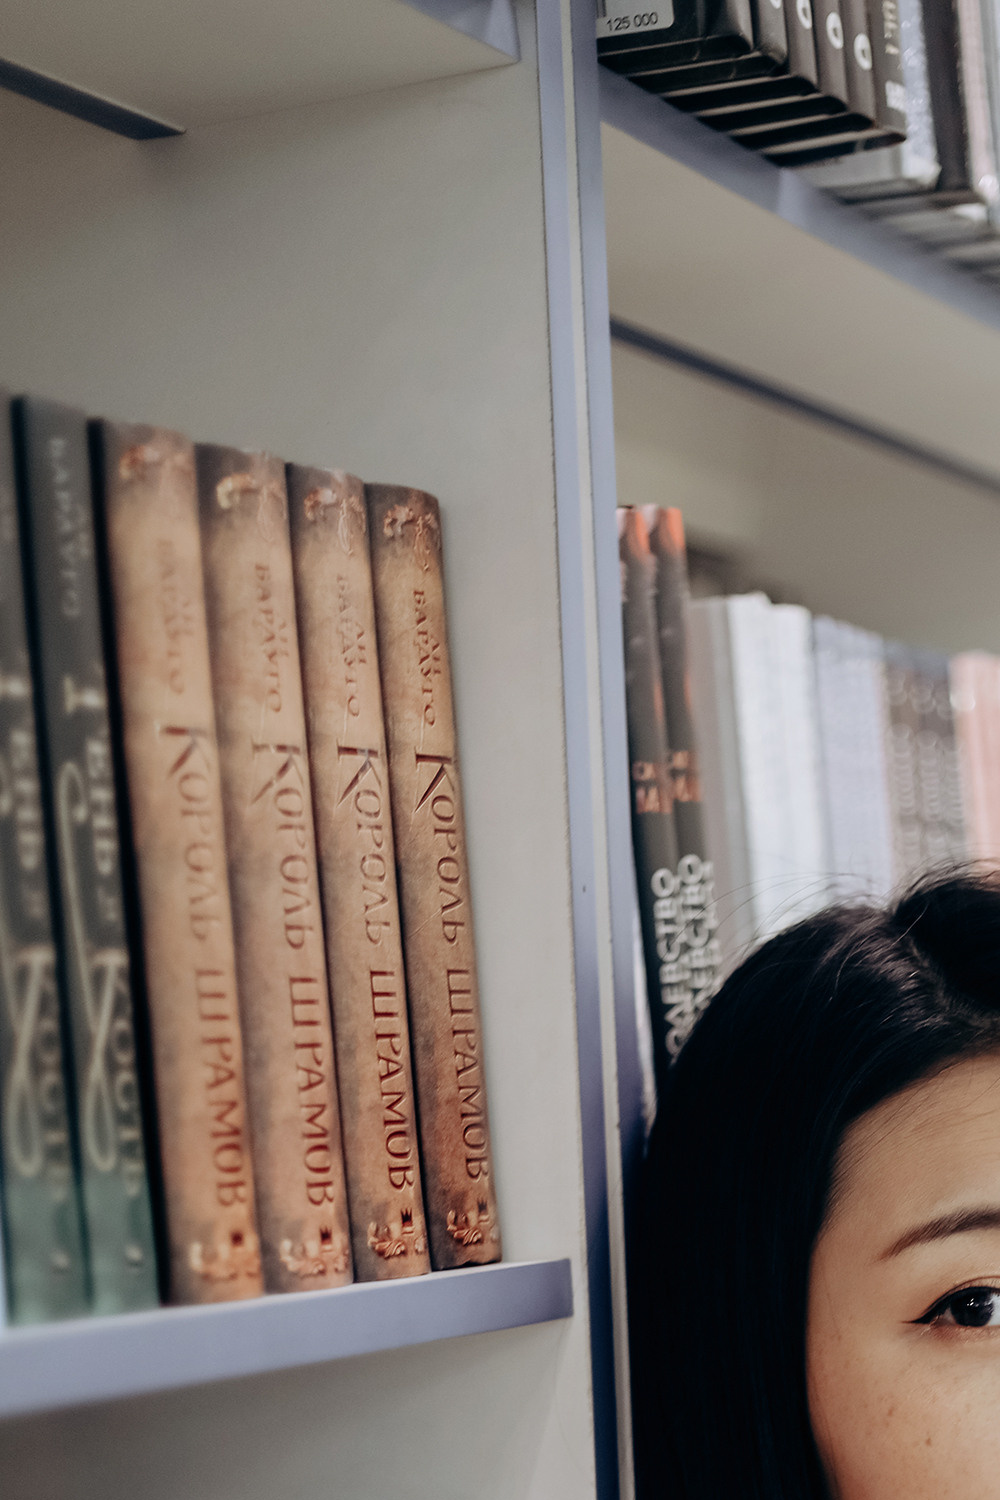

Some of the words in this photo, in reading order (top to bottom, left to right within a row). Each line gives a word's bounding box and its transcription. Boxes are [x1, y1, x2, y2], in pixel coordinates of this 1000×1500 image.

[195, 967, 247, 1208] ШРАМОВ
[250, 743, 315, 950] КОРОЛЬ
[289, 976, 335, 1207] ШРАМОВ
[336, 743, 391, 947] КОРОЛЬ
[369, 968, 415, 1191] ШРАМОВ
[414, 752, 467, 946] КОРОЛЬ
[446, 968, 489, 1181] ШРАМОВ
